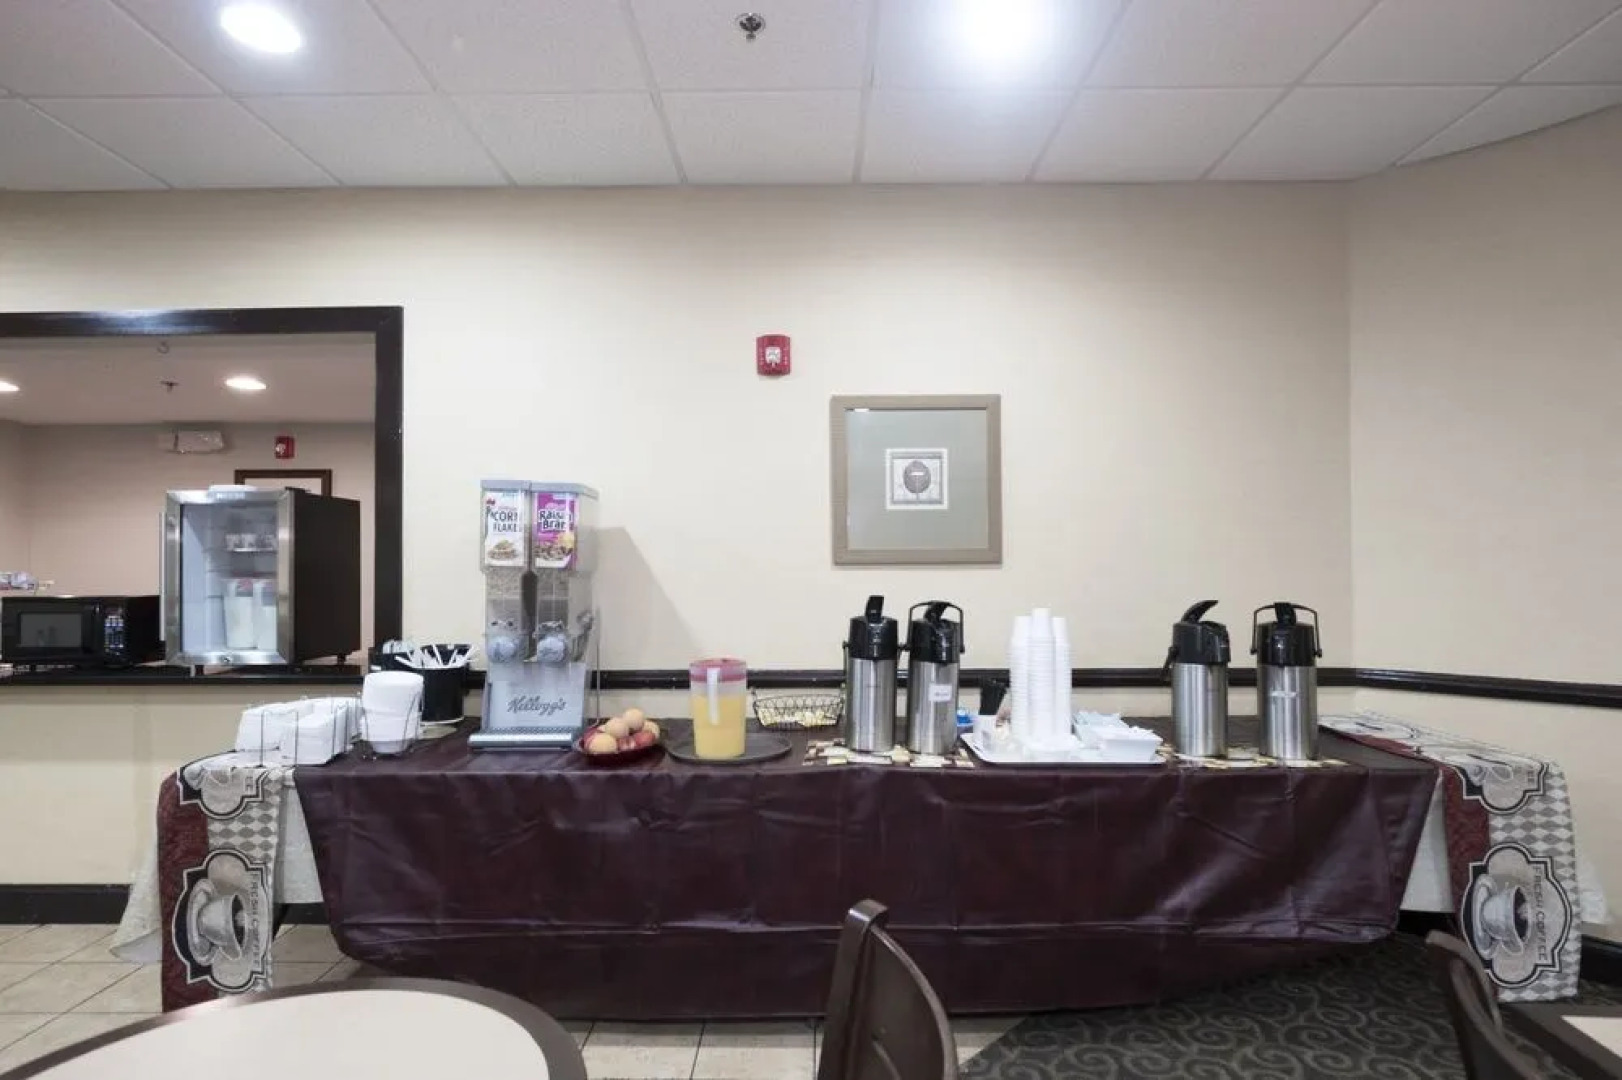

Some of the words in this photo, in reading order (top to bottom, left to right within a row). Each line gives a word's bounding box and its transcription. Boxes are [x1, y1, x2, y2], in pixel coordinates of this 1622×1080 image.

[540, 510, 572, 521] Rais
[493, 523, 520, 532] FLAKE
[507, 695, 567, 715] Kellogg's
